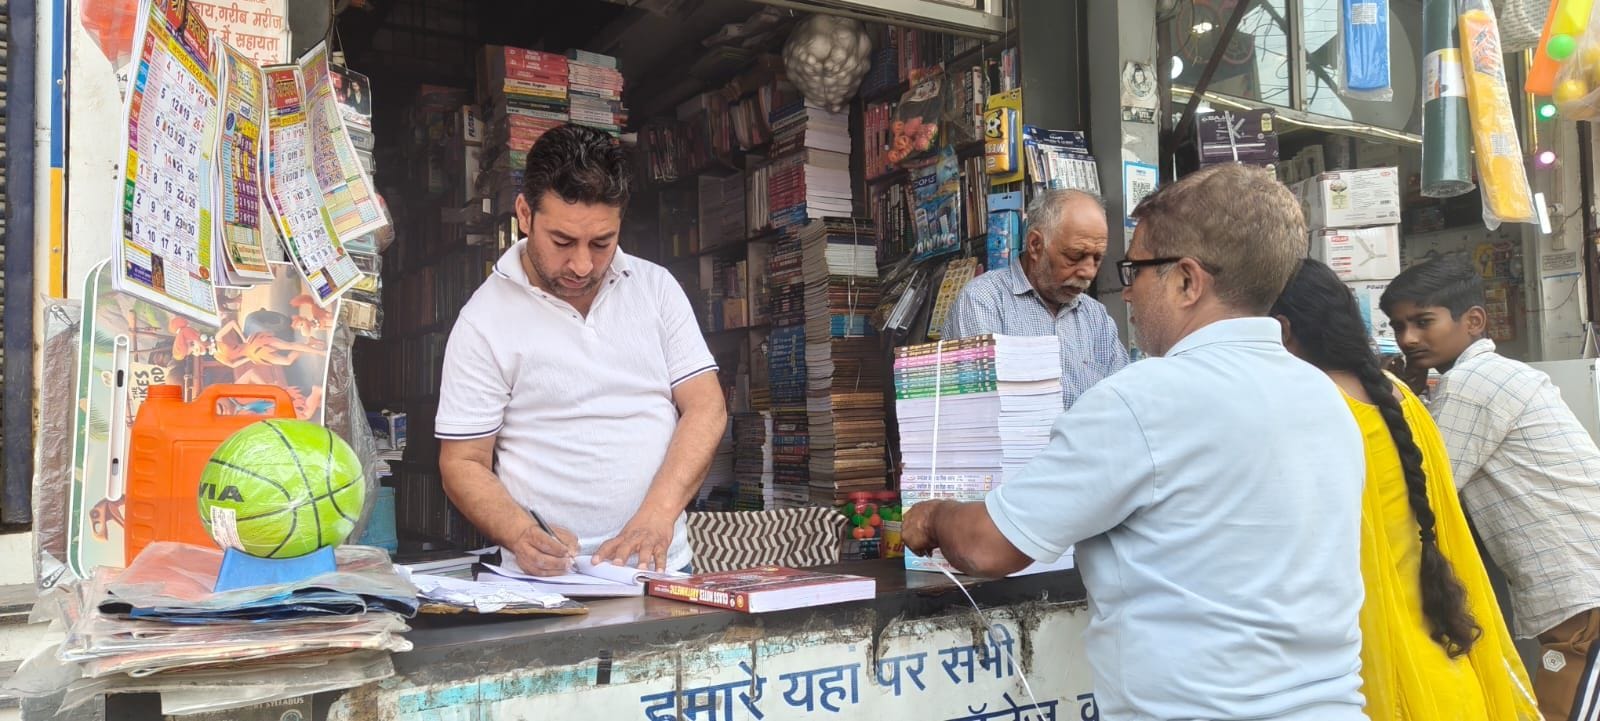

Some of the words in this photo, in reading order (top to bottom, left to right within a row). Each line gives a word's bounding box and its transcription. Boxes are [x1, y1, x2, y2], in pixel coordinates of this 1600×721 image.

[218, 2, 250, 24] गरीब
[252, 8, 283, 30] मरीज
[235, 32, 280, 51] सहायता
[177, 71, 184, 84] 11
[160, 87, 166, 99] 5
[172, 97, 179, 111] 12
[155, 115, 160, 127] 6
[167, 125, 174, 138] 13
[177, 134, 185, 147] 20
[188, 143, 196, 155] 27
[153, 143, 157, 154] 7
[165, 152, 172, 168] 14
[140, 164, 144, 175] 1
[153, 172, 158, 184] 8
[165, 180, 172, 193] 15
[177, 189, 184, 202] 22
[136, 192, 142, 205] 2
[151, 201, 155, 213] 9
[163, 208, 170, 221] 16
[175, 216, 183, 229] 23
[187, 223, 195, 236] 30
[135, 222, 140, 234] 3
[148, 229, 156, 243] 10
[161, 237, 169, 250] 17
[174, 244, 182, 256] 24
[185, 250, 193, 264] 31
[916, 232, 956, 255] AINTING
[134, 370, 150, 403] IKES
[151, 367, 166, 385] RD
[131, 386, 139, 400] THE
[640, 661, 767, 721] हमारे
[876, 651, 928, 696] पर
[938, 623, 1015, 684] सभी
